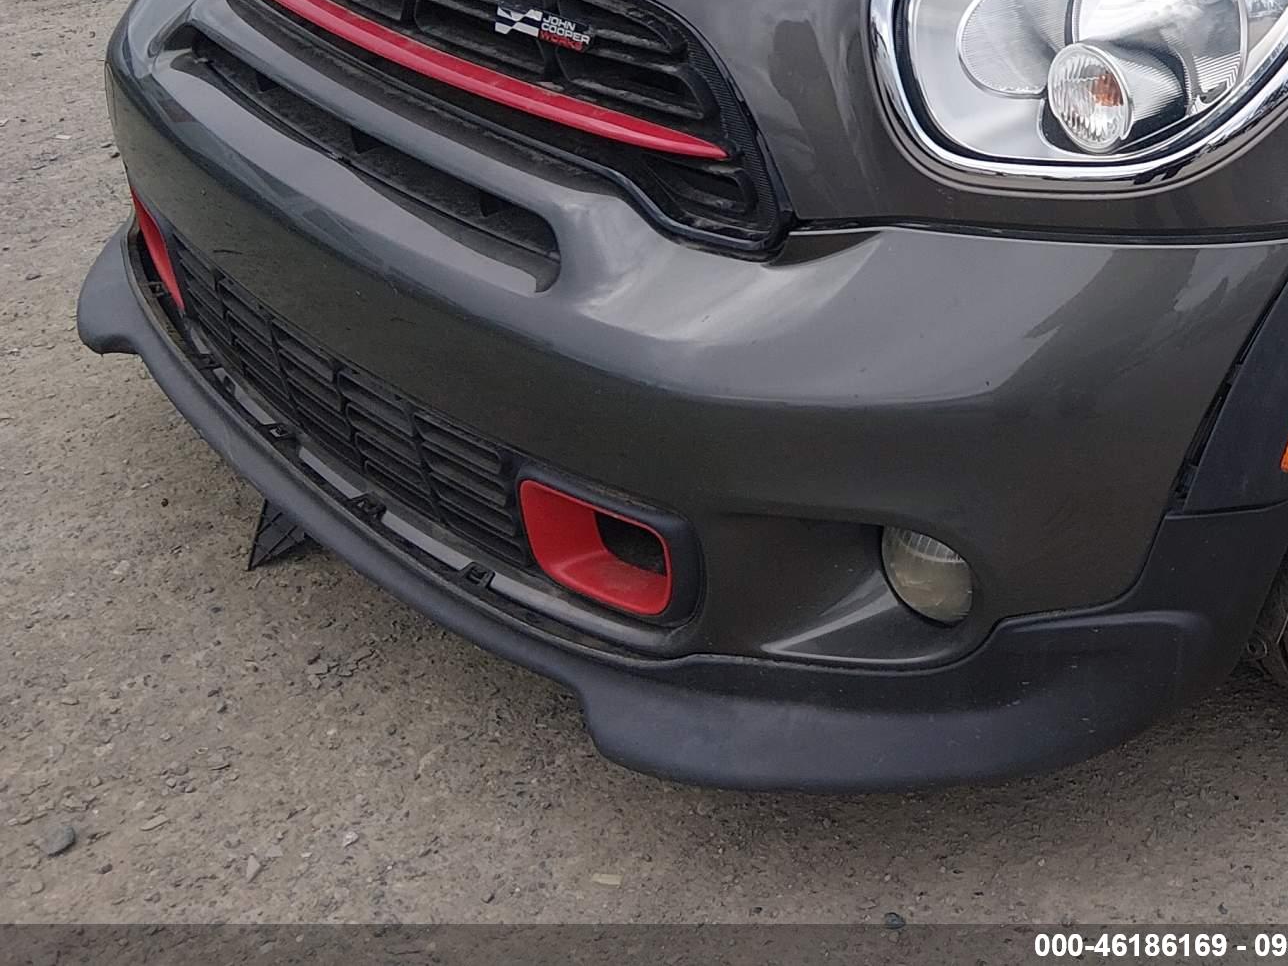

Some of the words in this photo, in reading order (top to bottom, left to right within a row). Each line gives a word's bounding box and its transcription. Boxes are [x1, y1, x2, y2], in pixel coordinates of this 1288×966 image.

[541, 22, 591, 44] COOPER
[542, 15, 577, 31] JOHN
[540, 31, 583, 51] WORKS
